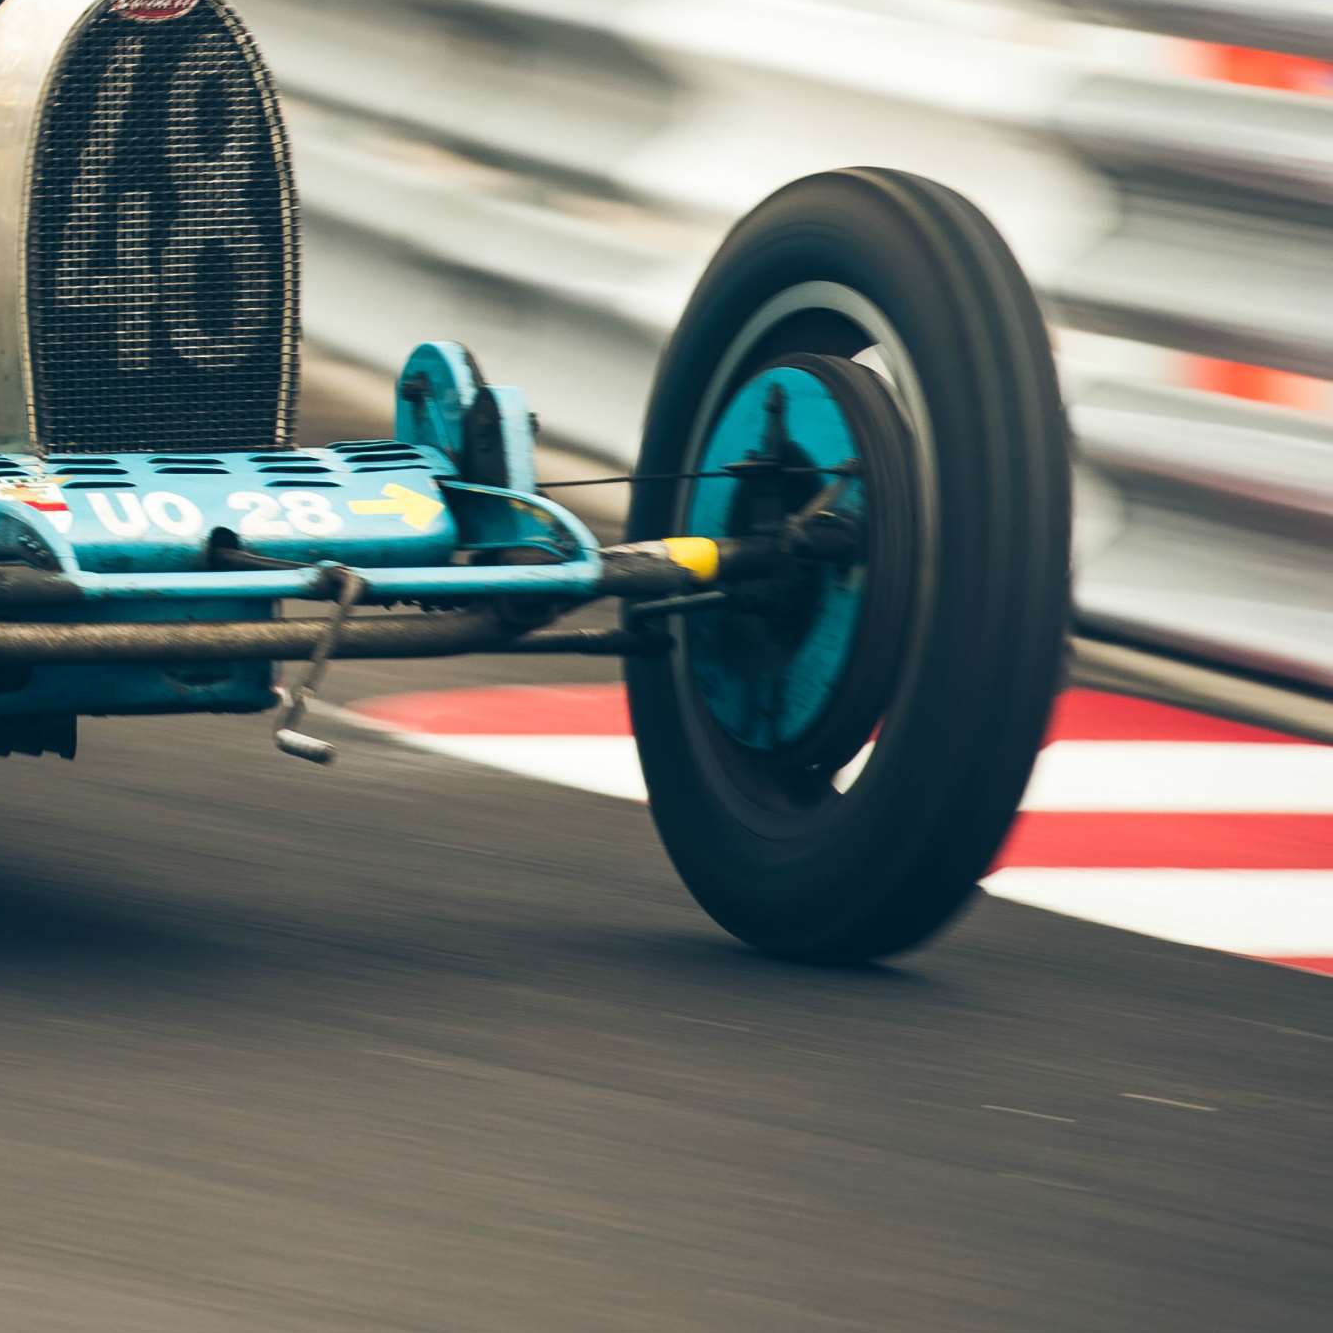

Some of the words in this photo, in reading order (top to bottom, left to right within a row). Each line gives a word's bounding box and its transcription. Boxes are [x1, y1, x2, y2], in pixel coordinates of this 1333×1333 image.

[52, 28, 271, 375] 48
[85, 490, 204, 538] UO
[228, 490, 344, 536] 28
